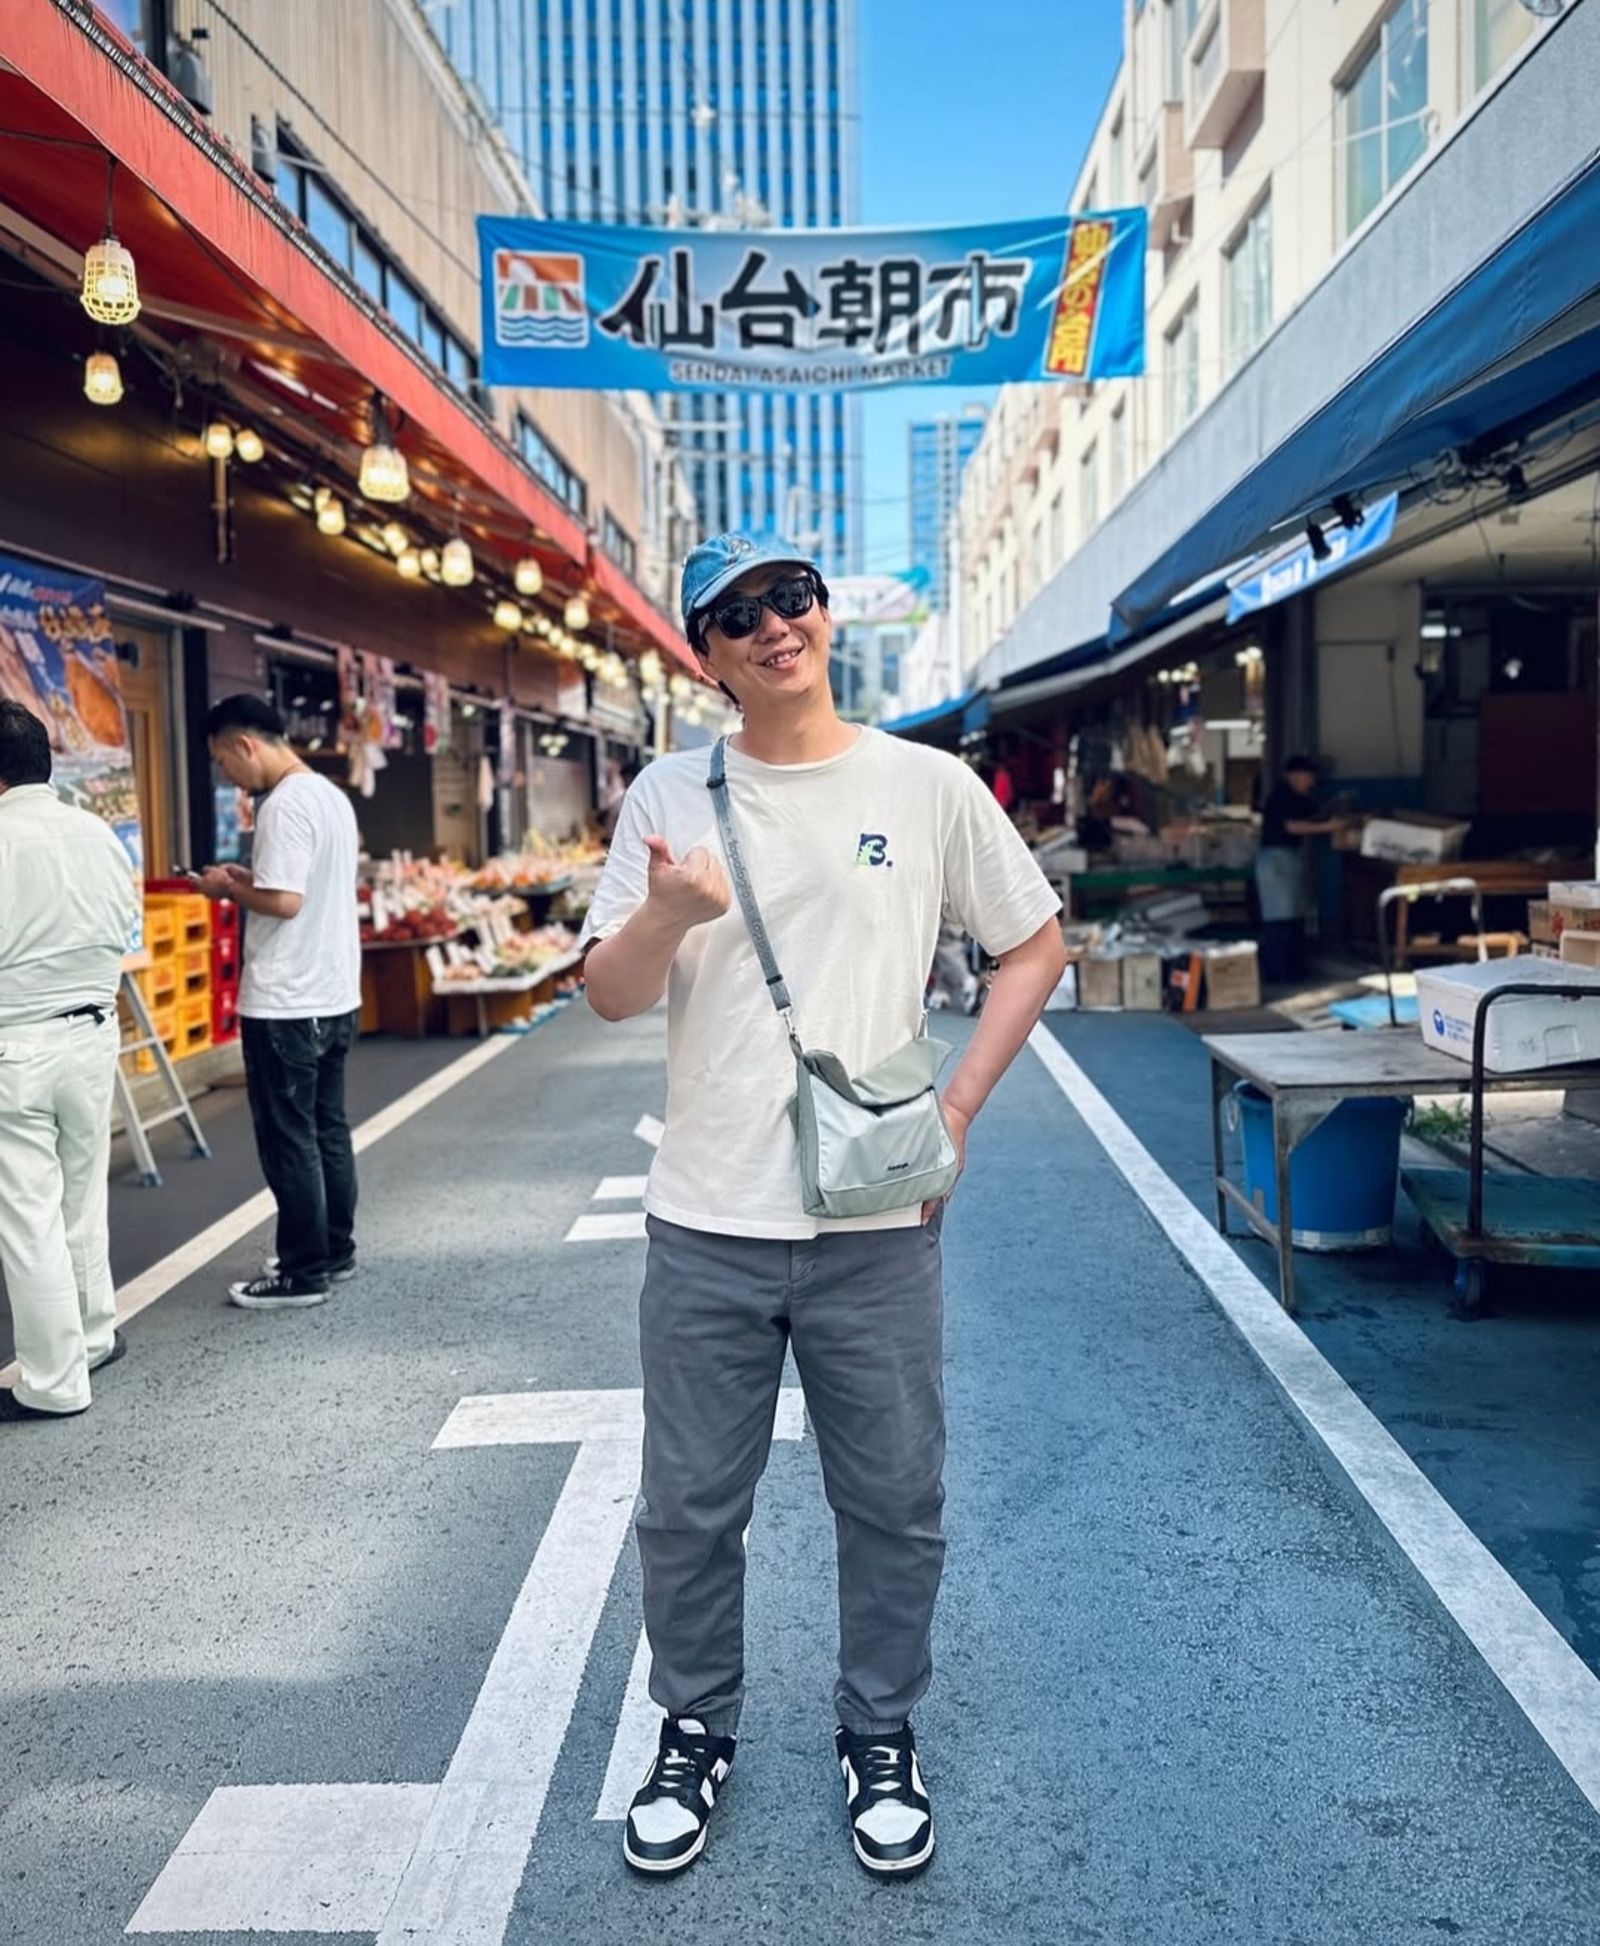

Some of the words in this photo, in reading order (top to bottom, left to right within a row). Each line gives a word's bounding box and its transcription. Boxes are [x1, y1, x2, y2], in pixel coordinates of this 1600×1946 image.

[599, 250, 1027, 355] 仙台朝市
[671, 361, 747, 384] SENDAI
[754, 366, 854, 385] ASAICHI
[861, 358, 950, 380] MARKET
